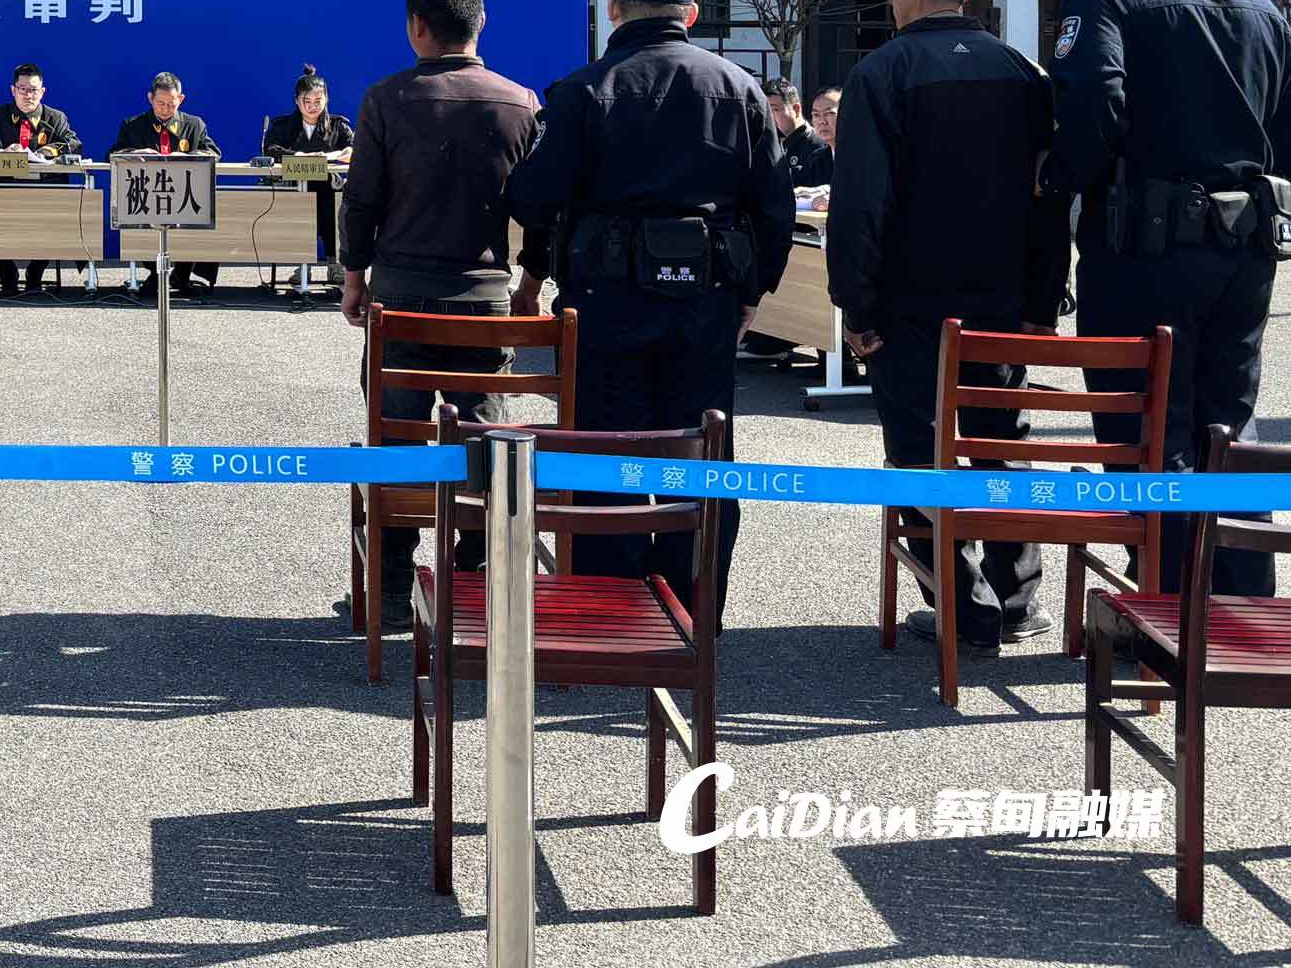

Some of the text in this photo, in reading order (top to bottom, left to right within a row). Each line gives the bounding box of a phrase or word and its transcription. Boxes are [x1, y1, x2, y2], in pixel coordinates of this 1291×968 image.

[125, 168, 202, 216] 被告人
[131, 452, 308, 476] 警察 POLICE
[620, 463, 806, 494] 警察 POLICE
[986, 478, 1182, 505] 警察 POLICE
